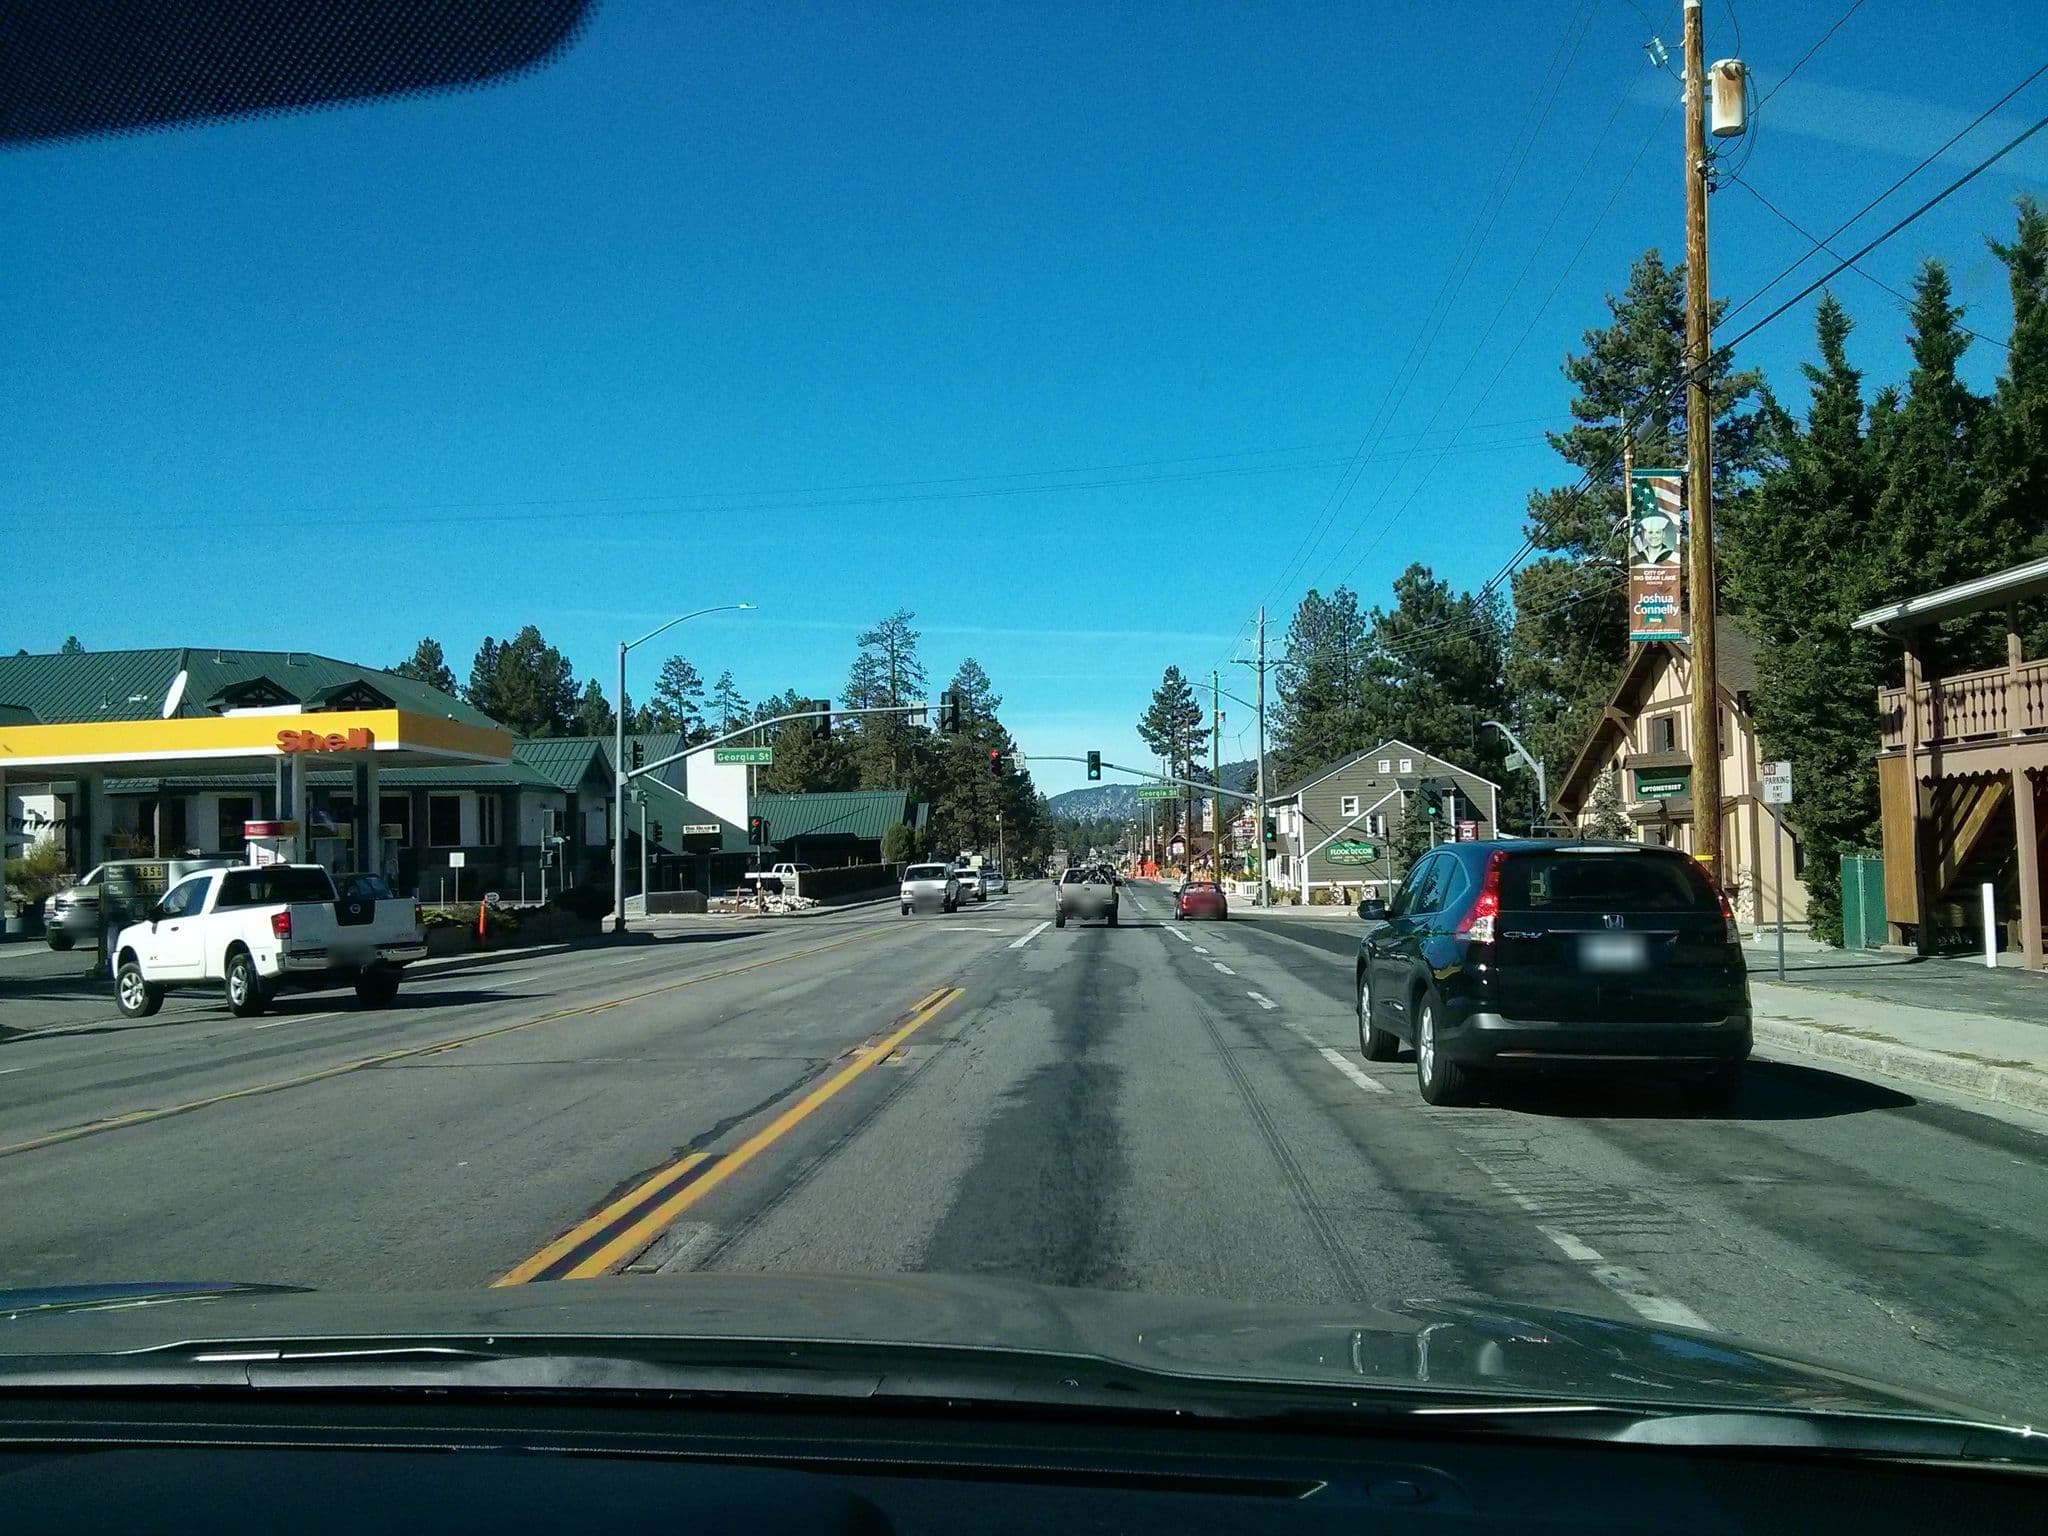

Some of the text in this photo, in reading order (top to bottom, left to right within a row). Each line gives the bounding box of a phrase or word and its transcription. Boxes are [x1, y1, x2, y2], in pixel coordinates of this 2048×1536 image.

[1637, 592, 1674, 604] Joshua
[1633, 604, 1680, 617] Connelly
[276, 727, 375, 753] Shell
[717, 752, 770, 763] Georgia St
[1764, 764, 1775, 775] NO
[1765, 775, 1790, 785] PARKING
[1139, 790, 1167, 798] Georgia
